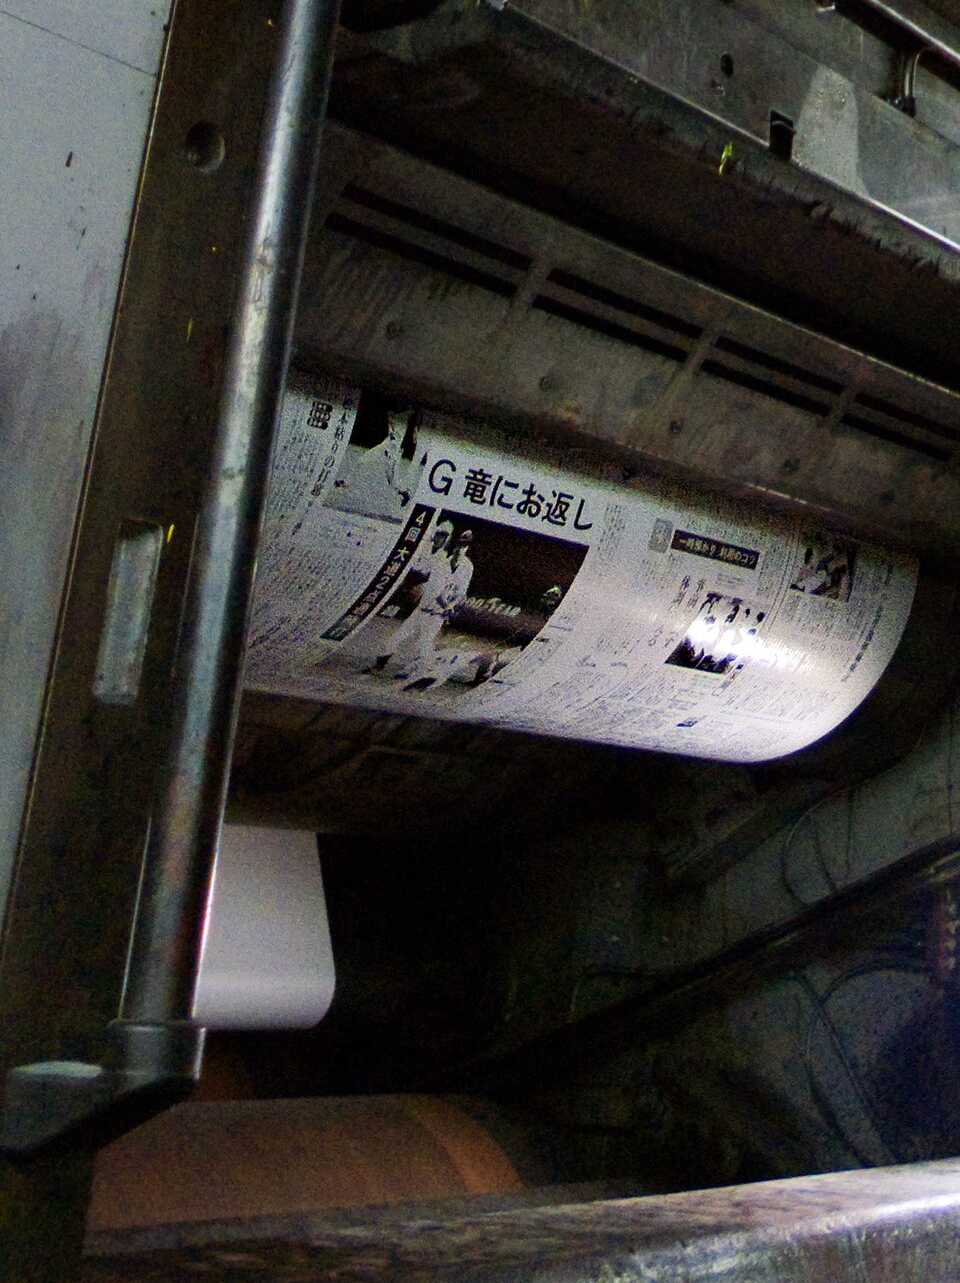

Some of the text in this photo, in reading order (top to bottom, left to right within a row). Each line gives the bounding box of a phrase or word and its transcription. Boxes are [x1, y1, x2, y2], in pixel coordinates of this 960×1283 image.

[463, 468, 593, 530] 竜にお返し
